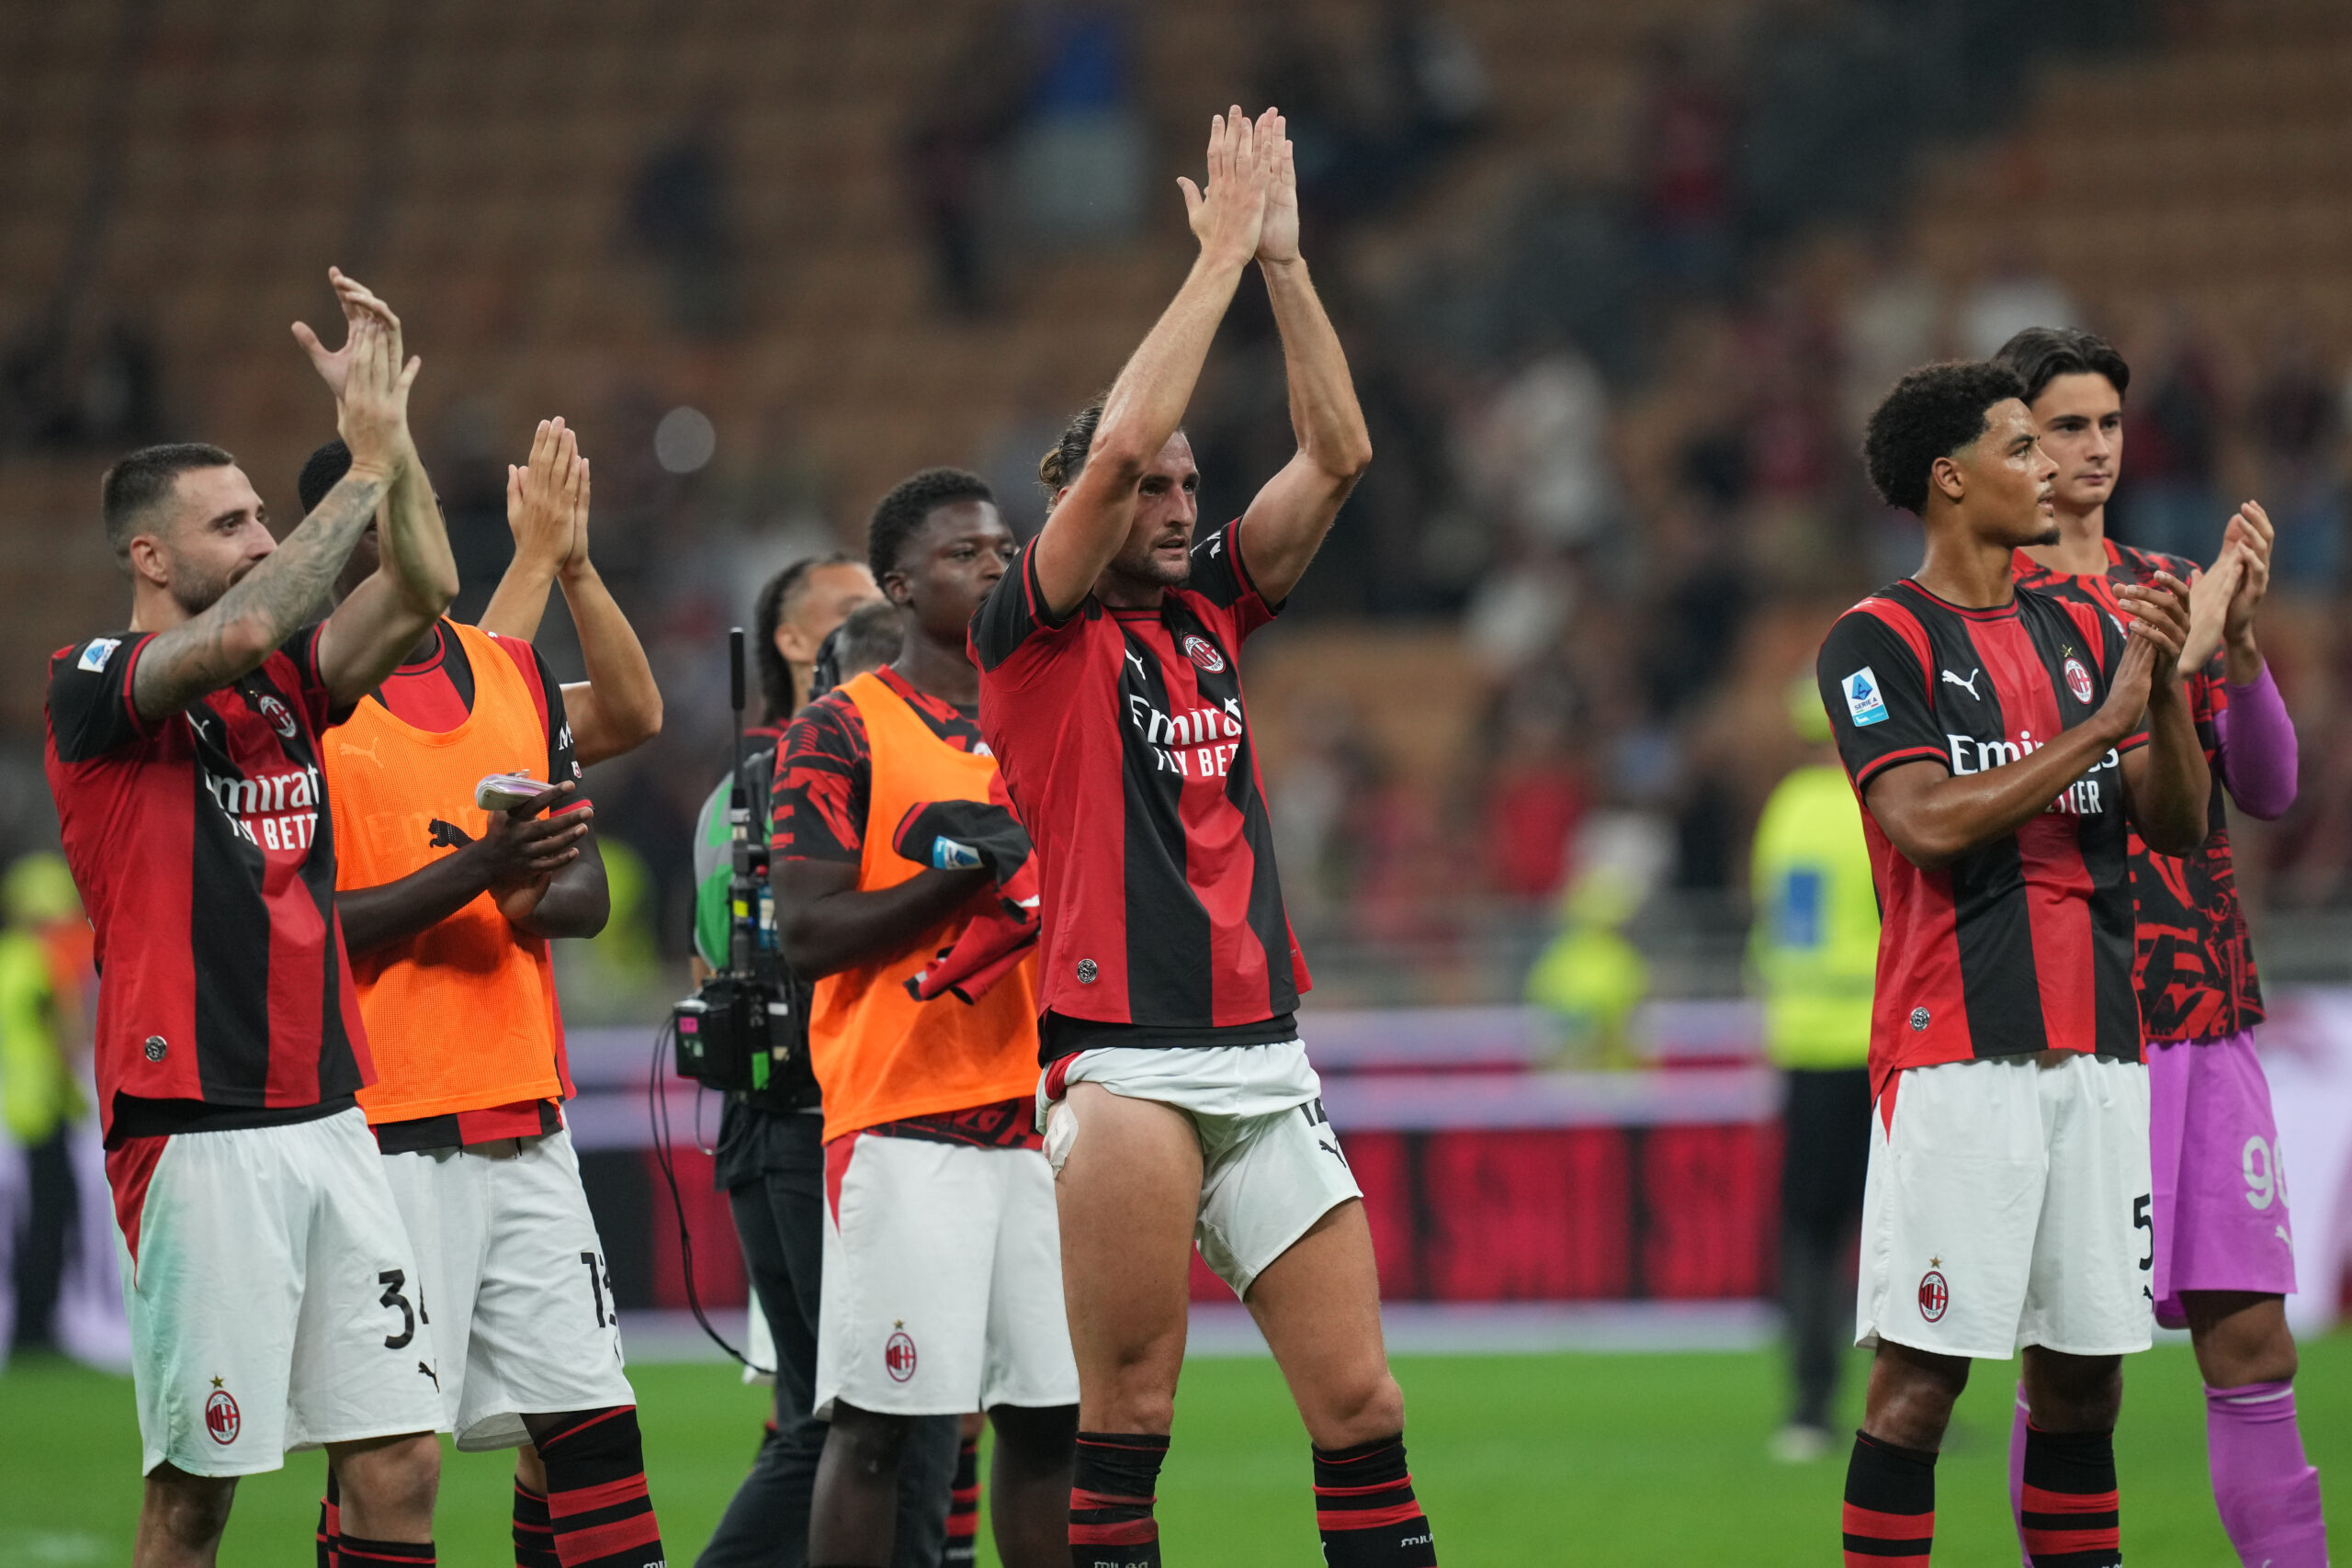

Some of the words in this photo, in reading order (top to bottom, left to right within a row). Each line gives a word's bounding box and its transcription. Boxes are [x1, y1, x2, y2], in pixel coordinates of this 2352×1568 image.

[1854, 699, 1871, 711] SERIE
[205, 762, 320, 814] mirat
[2133, 1193, 2154, 1271] 5
[379, 1269, 430, 1349] 3
